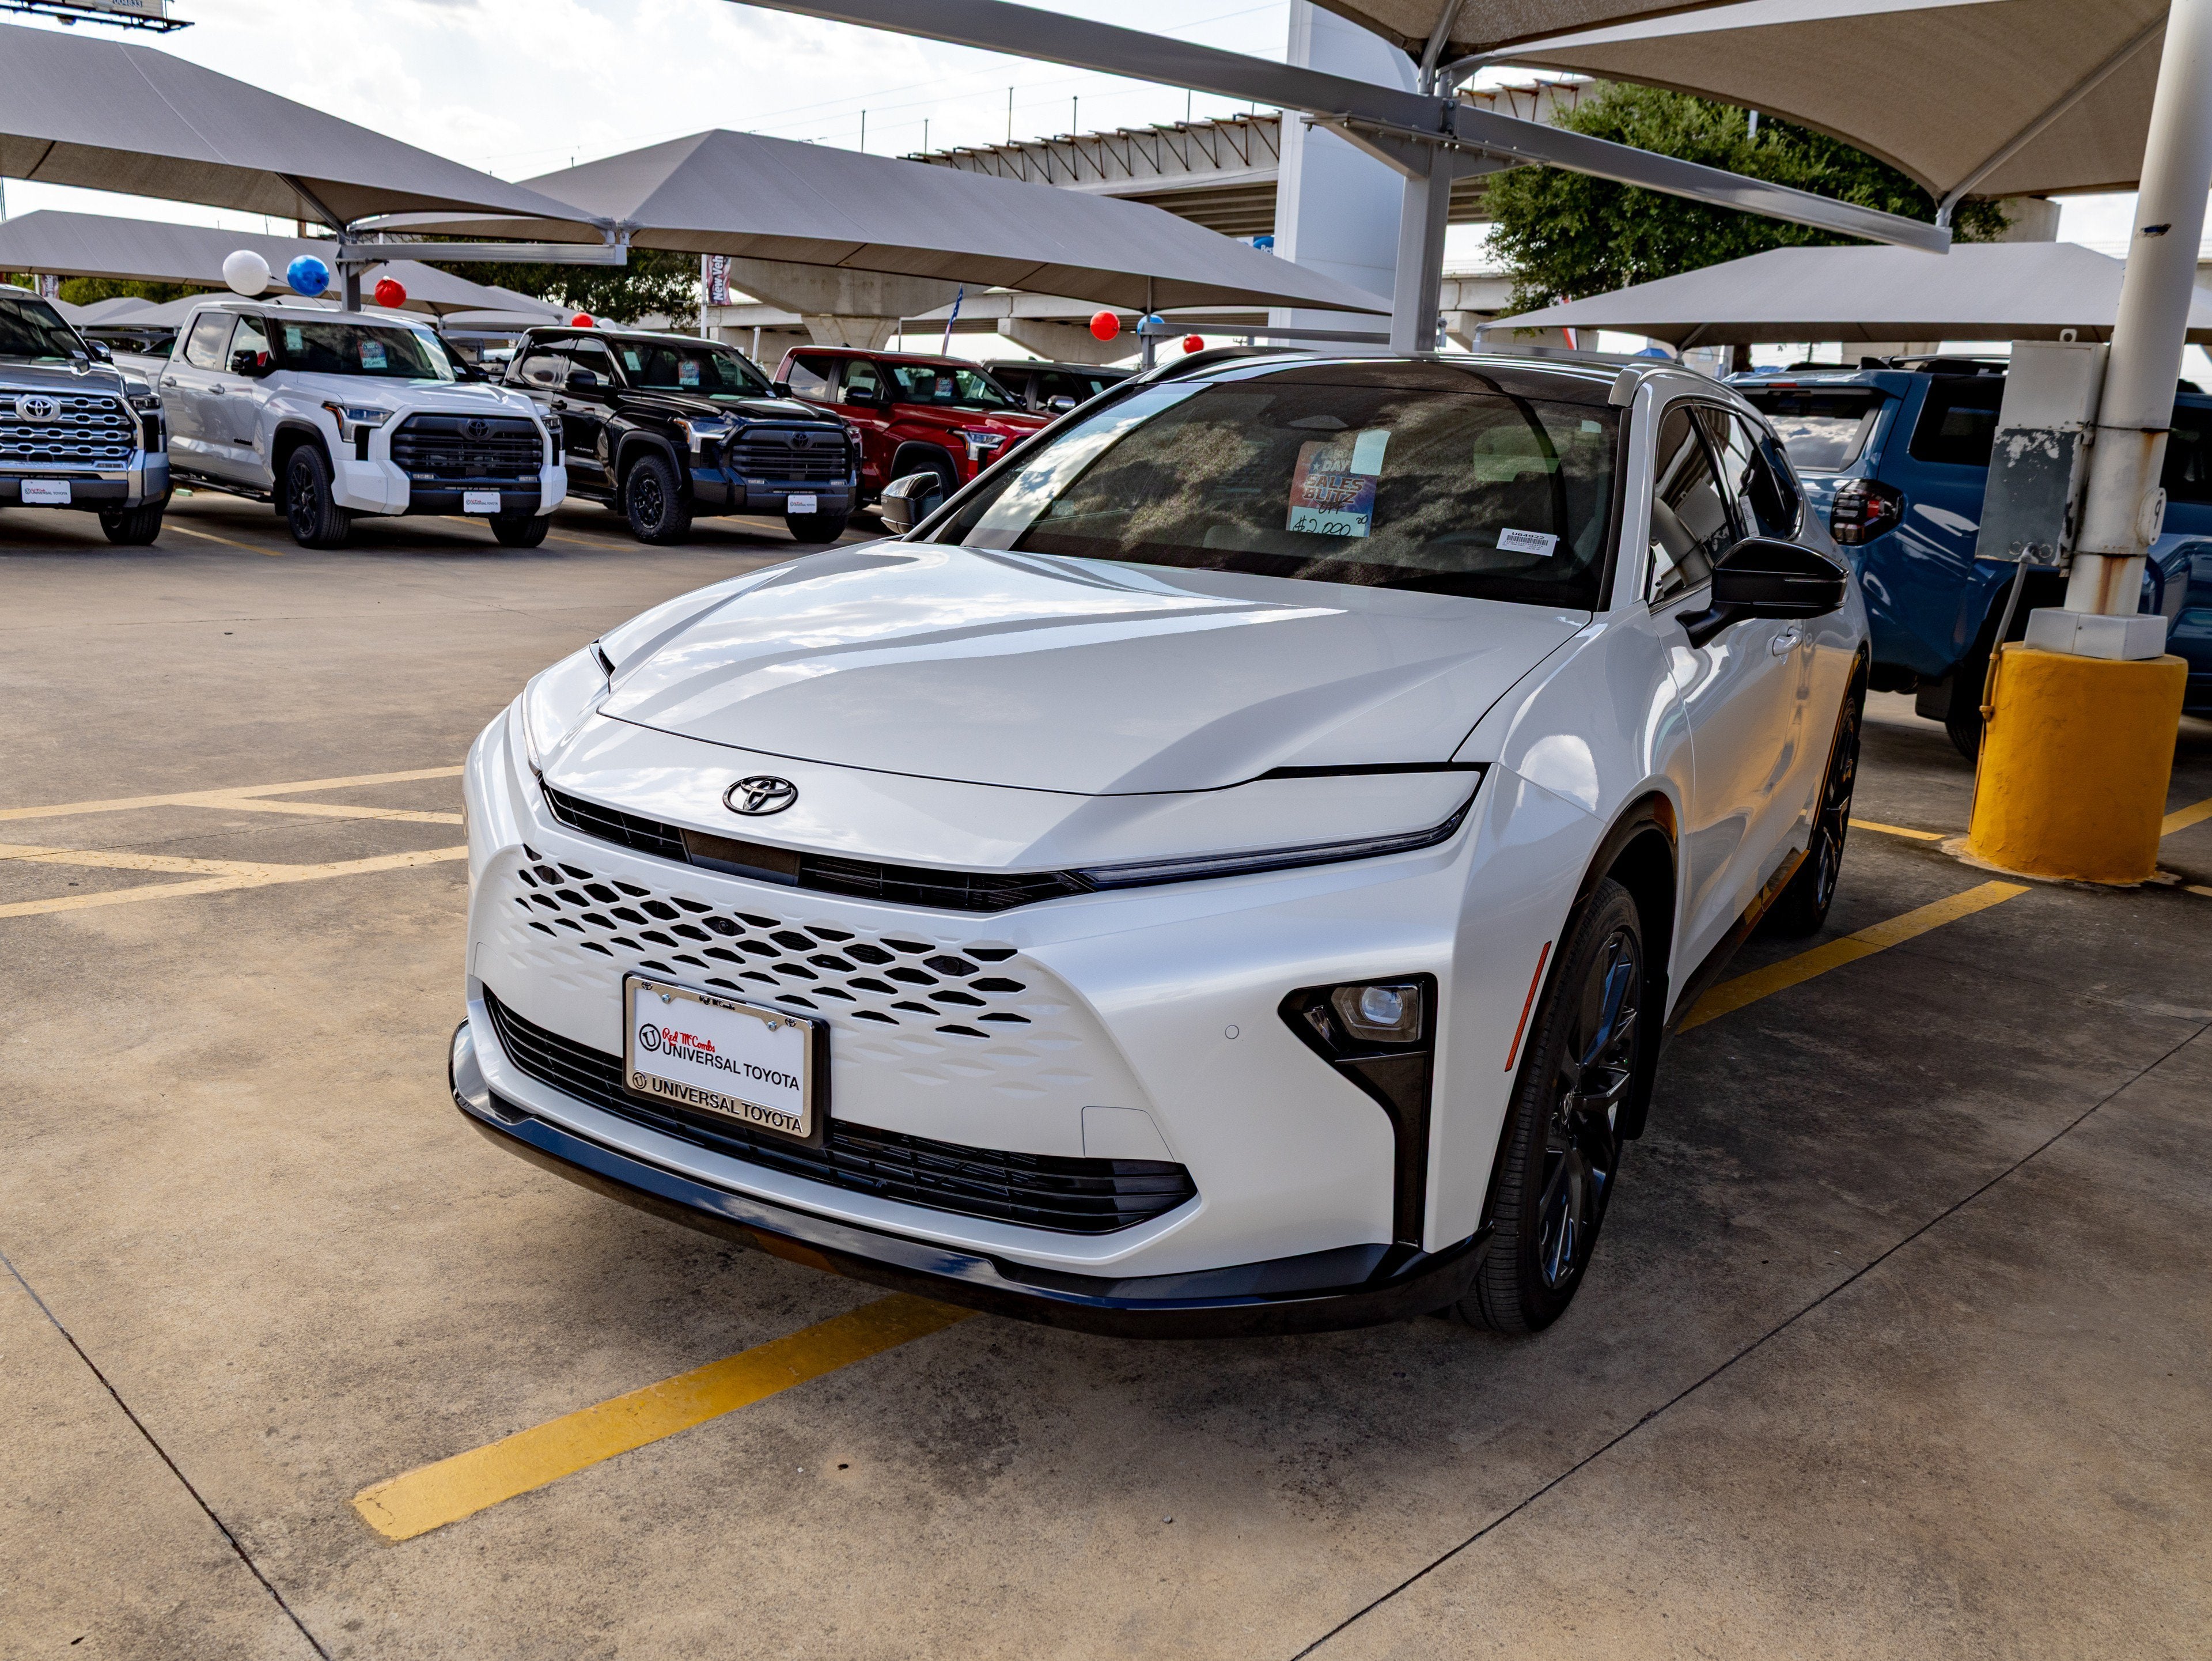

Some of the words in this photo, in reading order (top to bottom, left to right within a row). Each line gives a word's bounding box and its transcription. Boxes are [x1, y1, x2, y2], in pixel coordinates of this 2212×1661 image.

[1260, 244, 1274, 254] Bes
[713, 277, 724, 301] New
[1321, 460, 1351, 472] DAY
[1305, 475, 1365, 491] SALES
[1303, 487, 1358, 504] BLITZ
[2154, 499, 2162, 530] 9
[662, 1027, 679, 1046] Red
[679, 1031, 715, 1053] McCombs
[662, 1041, 741, 1074] UNIVERSAL
[743, 1063, 800, 1091] TOYOTA
[652, 1077, 740, 1115] UNIVERSAL
[741, 1103, 804, 1133] TOYOTA
